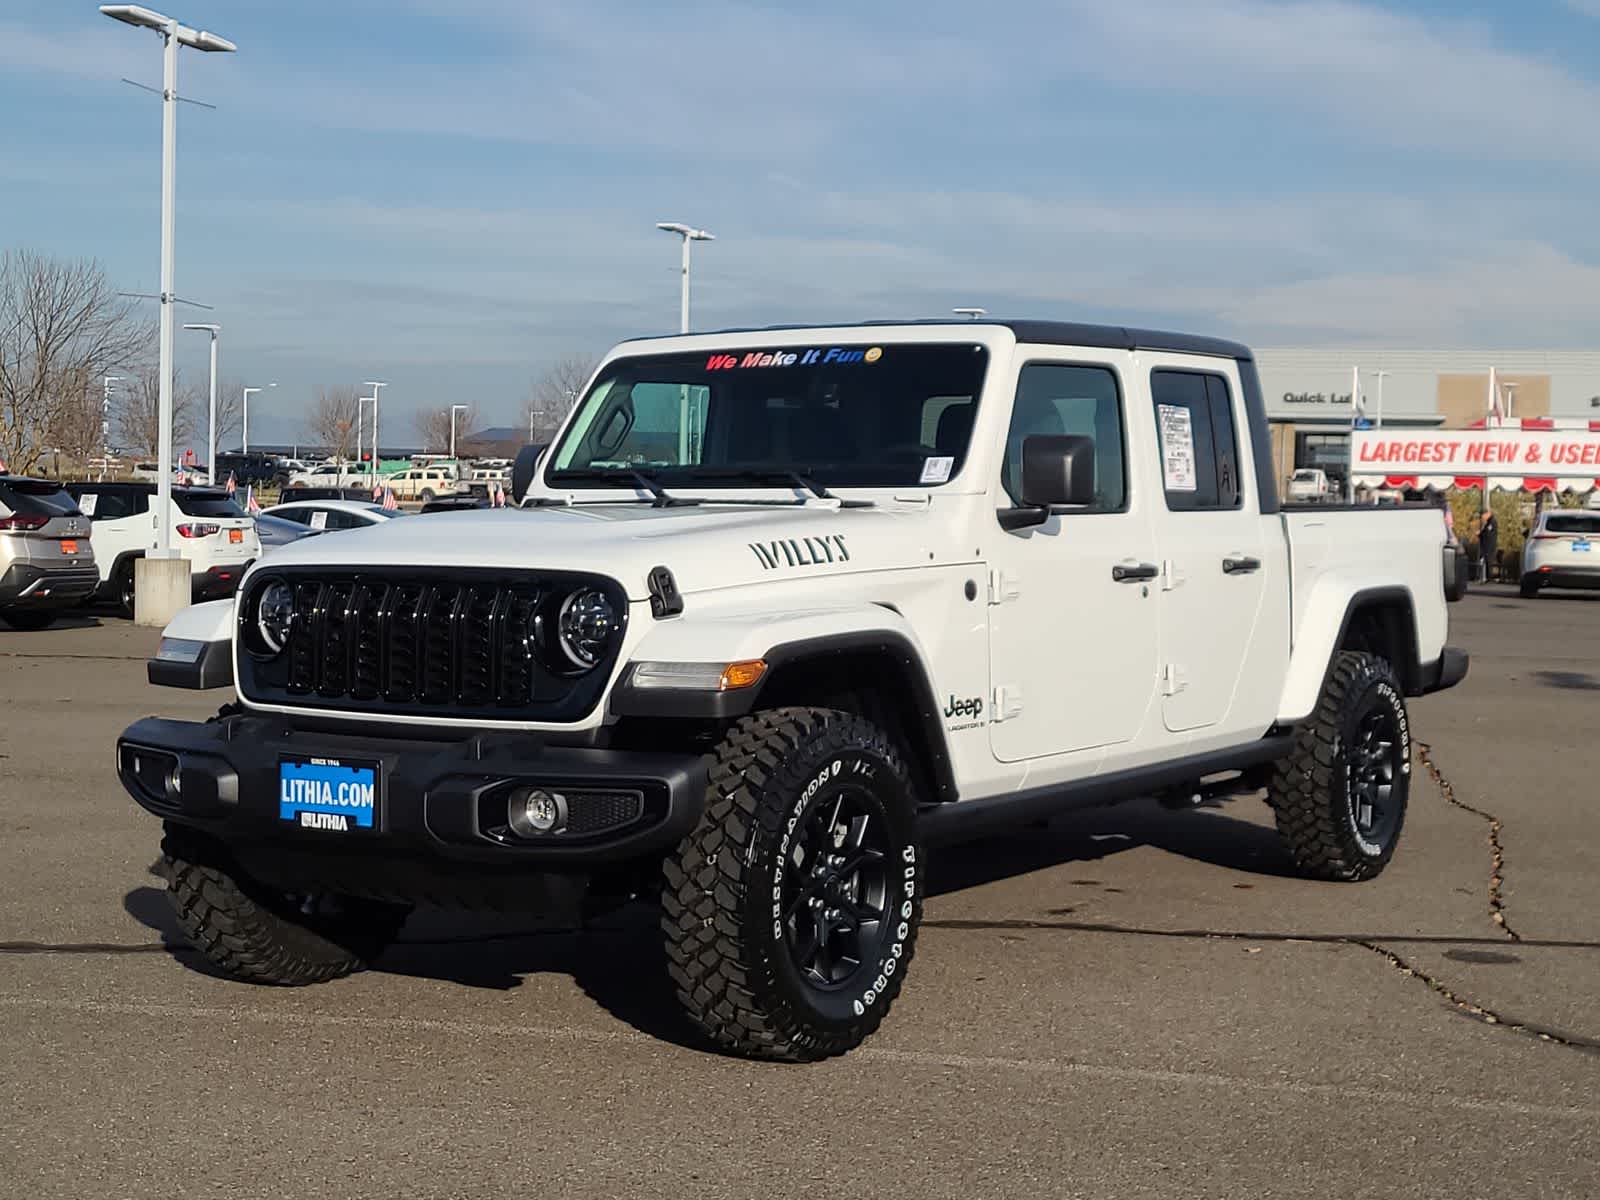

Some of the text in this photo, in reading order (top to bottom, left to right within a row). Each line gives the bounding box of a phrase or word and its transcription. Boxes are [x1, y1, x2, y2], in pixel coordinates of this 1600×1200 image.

[705, 348, 862, 371] We Make It Fun
[1283, 391, 1366, 404] Quick Lu
[1360, 442, 1461, 463] LARGEST
[1465, 442, 1520, 464] NEW
[1524, 443, 1543, 464] &
[748, 534, 850, 570] WILLYS
[944, 695, 983, 719] Jeep
[281, 778, 375, 809] LITHIA.COM
[312, 813, 348, 831] LITHIA
[773, 766, 830, 940] DESTINATION
